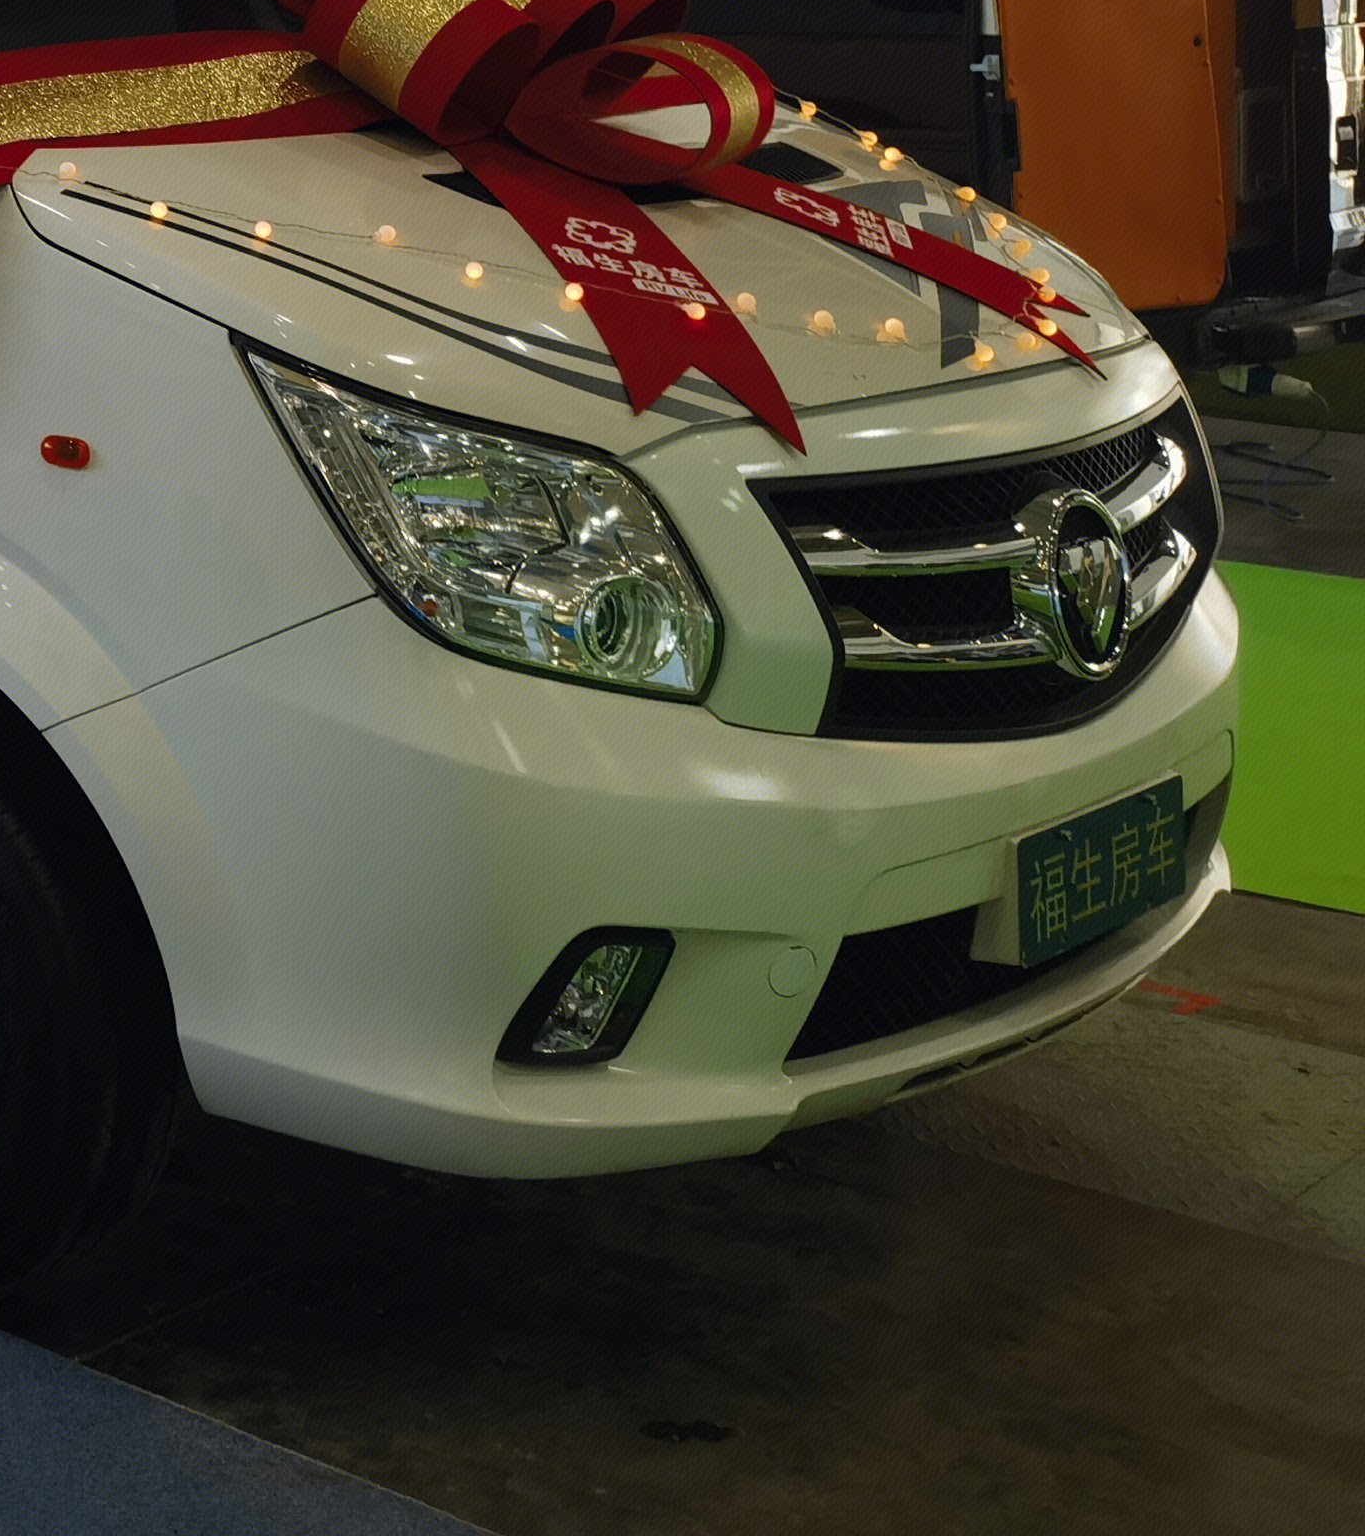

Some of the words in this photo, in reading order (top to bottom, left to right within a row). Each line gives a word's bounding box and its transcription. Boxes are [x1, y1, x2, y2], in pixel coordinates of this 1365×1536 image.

[551, 243, 705, 290] 福生房车
[1028, 814, 1177, 944] 福生房车
